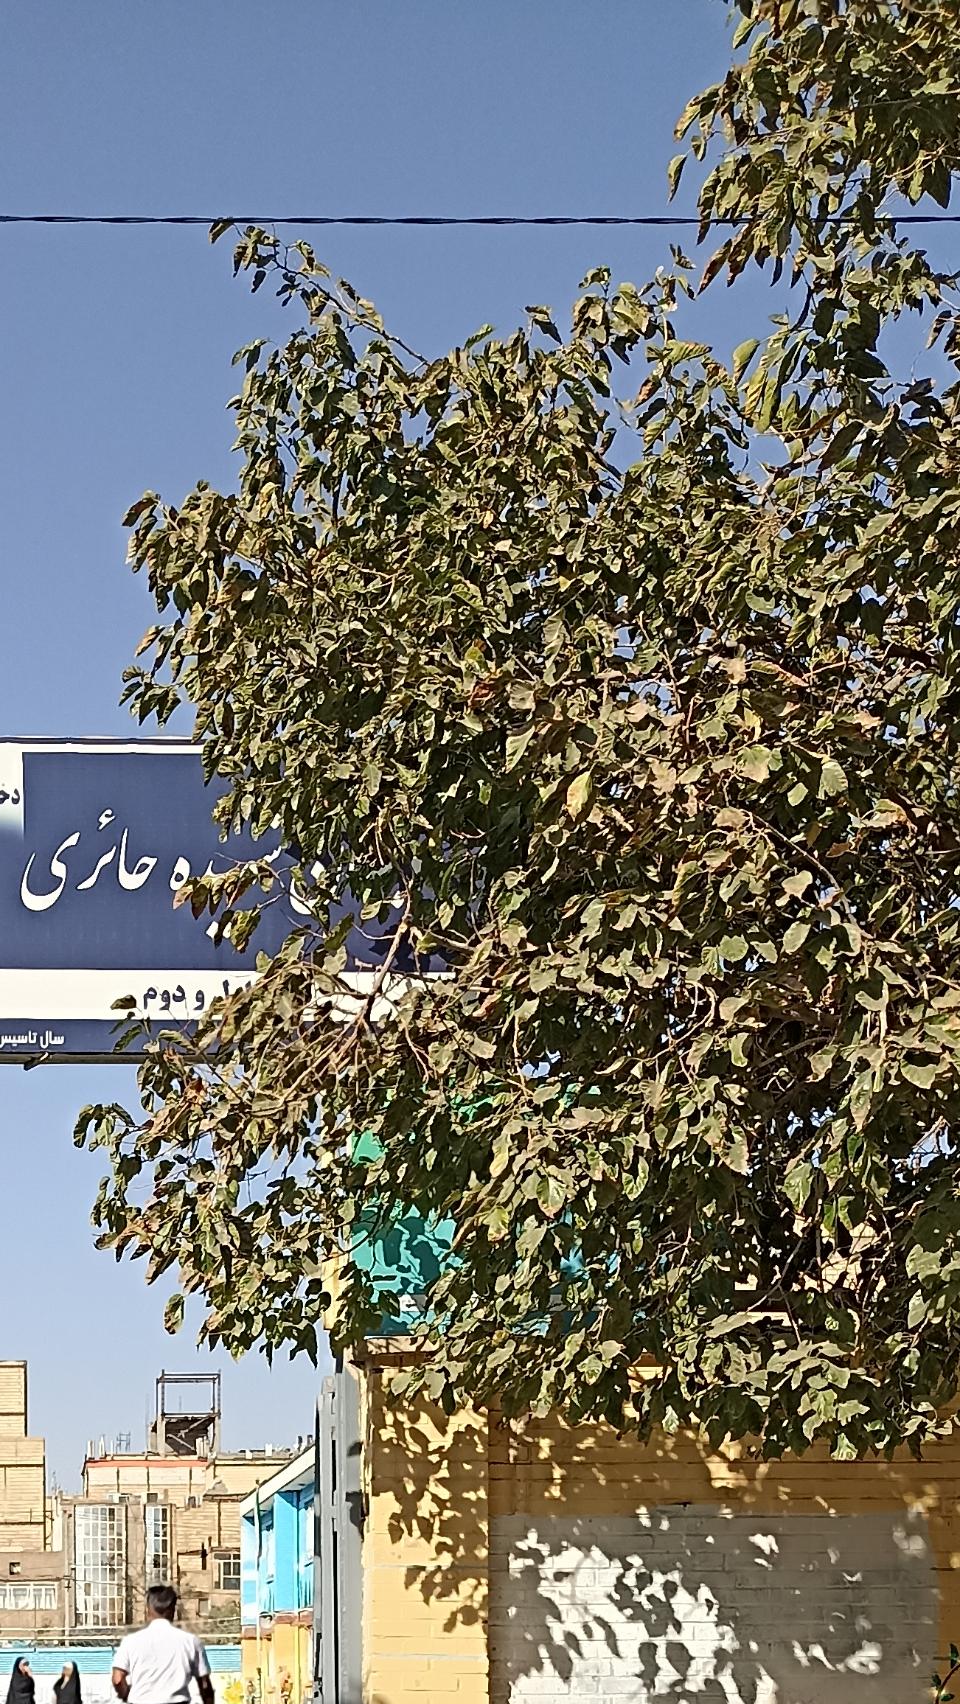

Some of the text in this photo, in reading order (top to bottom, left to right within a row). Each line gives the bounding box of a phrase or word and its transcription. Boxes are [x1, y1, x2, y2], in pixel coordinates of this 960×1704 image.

[20, 808, 158, 912] حائری
[143, 984, 205, 1011] و دوم
[40, 1030, 65, 1049] سال
